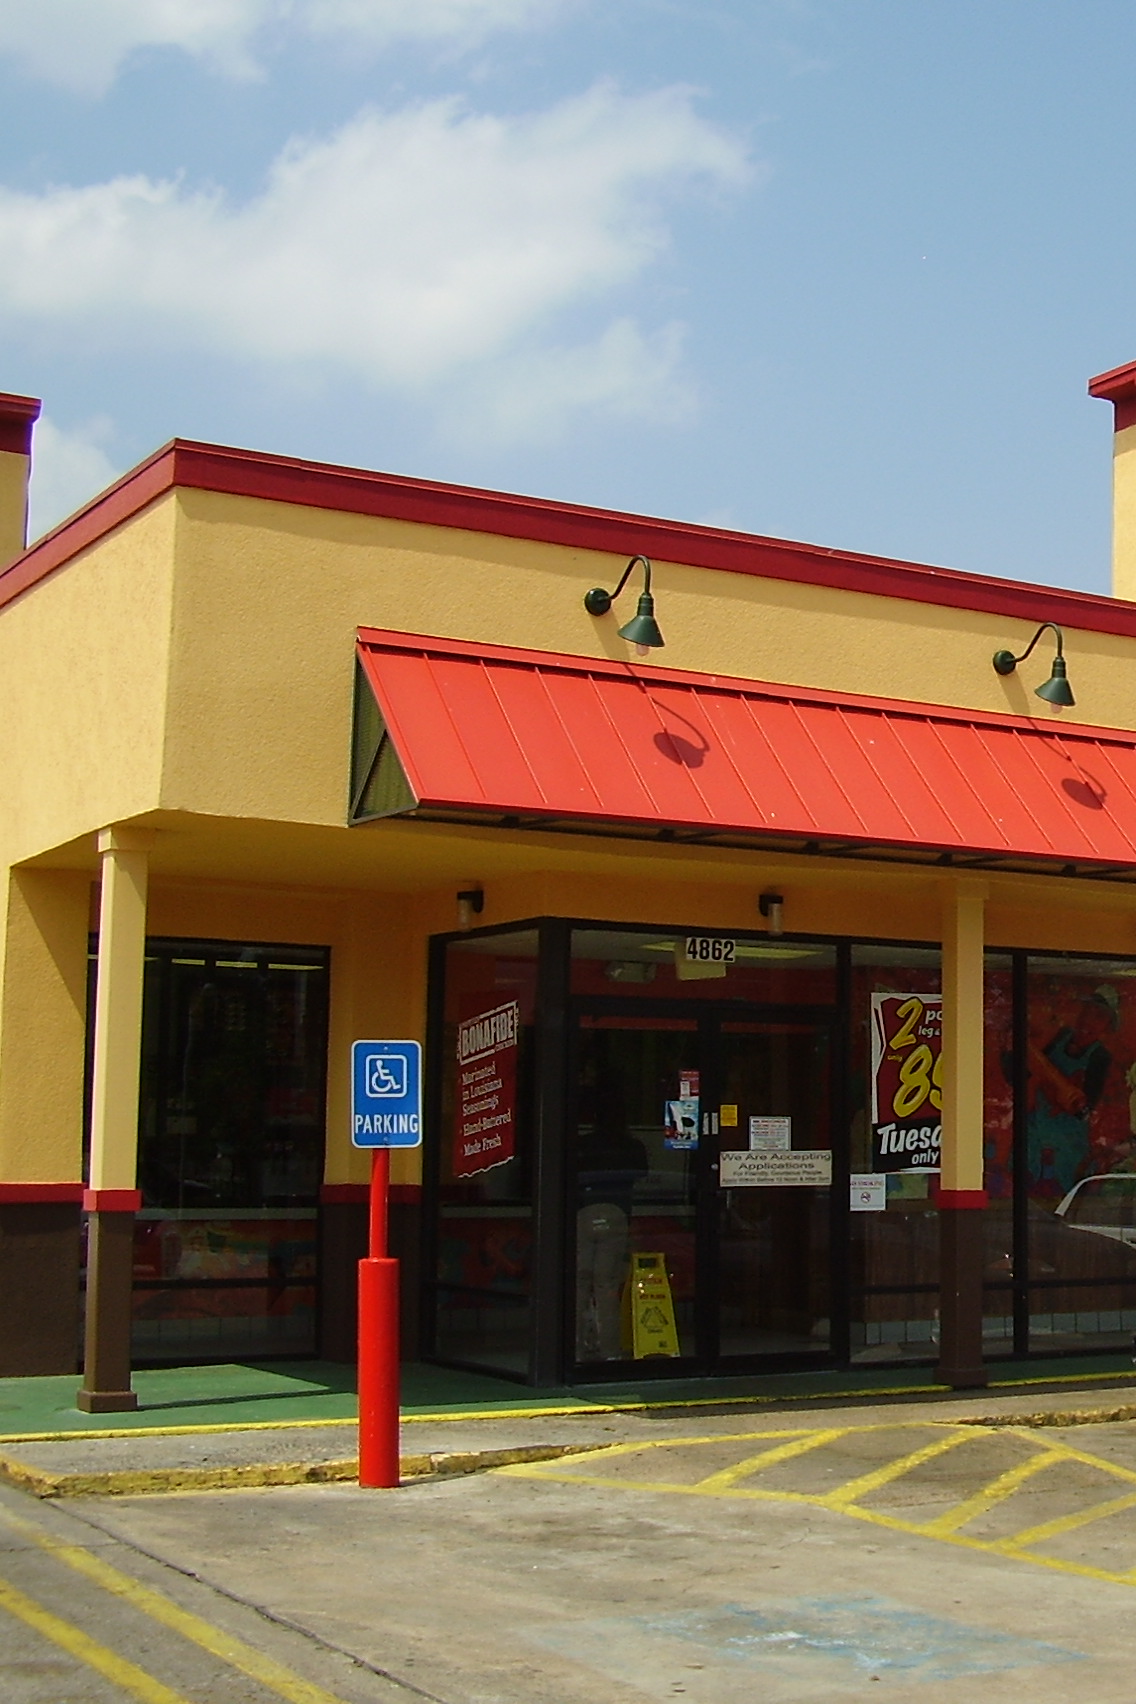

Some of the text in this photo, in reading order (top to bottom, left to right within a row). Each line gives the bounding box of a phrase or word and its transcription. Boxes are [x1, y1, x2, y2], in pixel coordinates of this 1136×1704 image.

[686, 937, 735, 962] 4862
[889, 997, 924, 1050] 2
[918, 1025, 933, 1039] leg
[462, 1010, 514, 1057] BONAFIDE
[355, 1114, 419, 1134] PARKING
[721, 1153, 831, 1162] We Are Accepting
[911, 1147, 940, 1165] only
[738, 1162, 815, 1170] Applications
